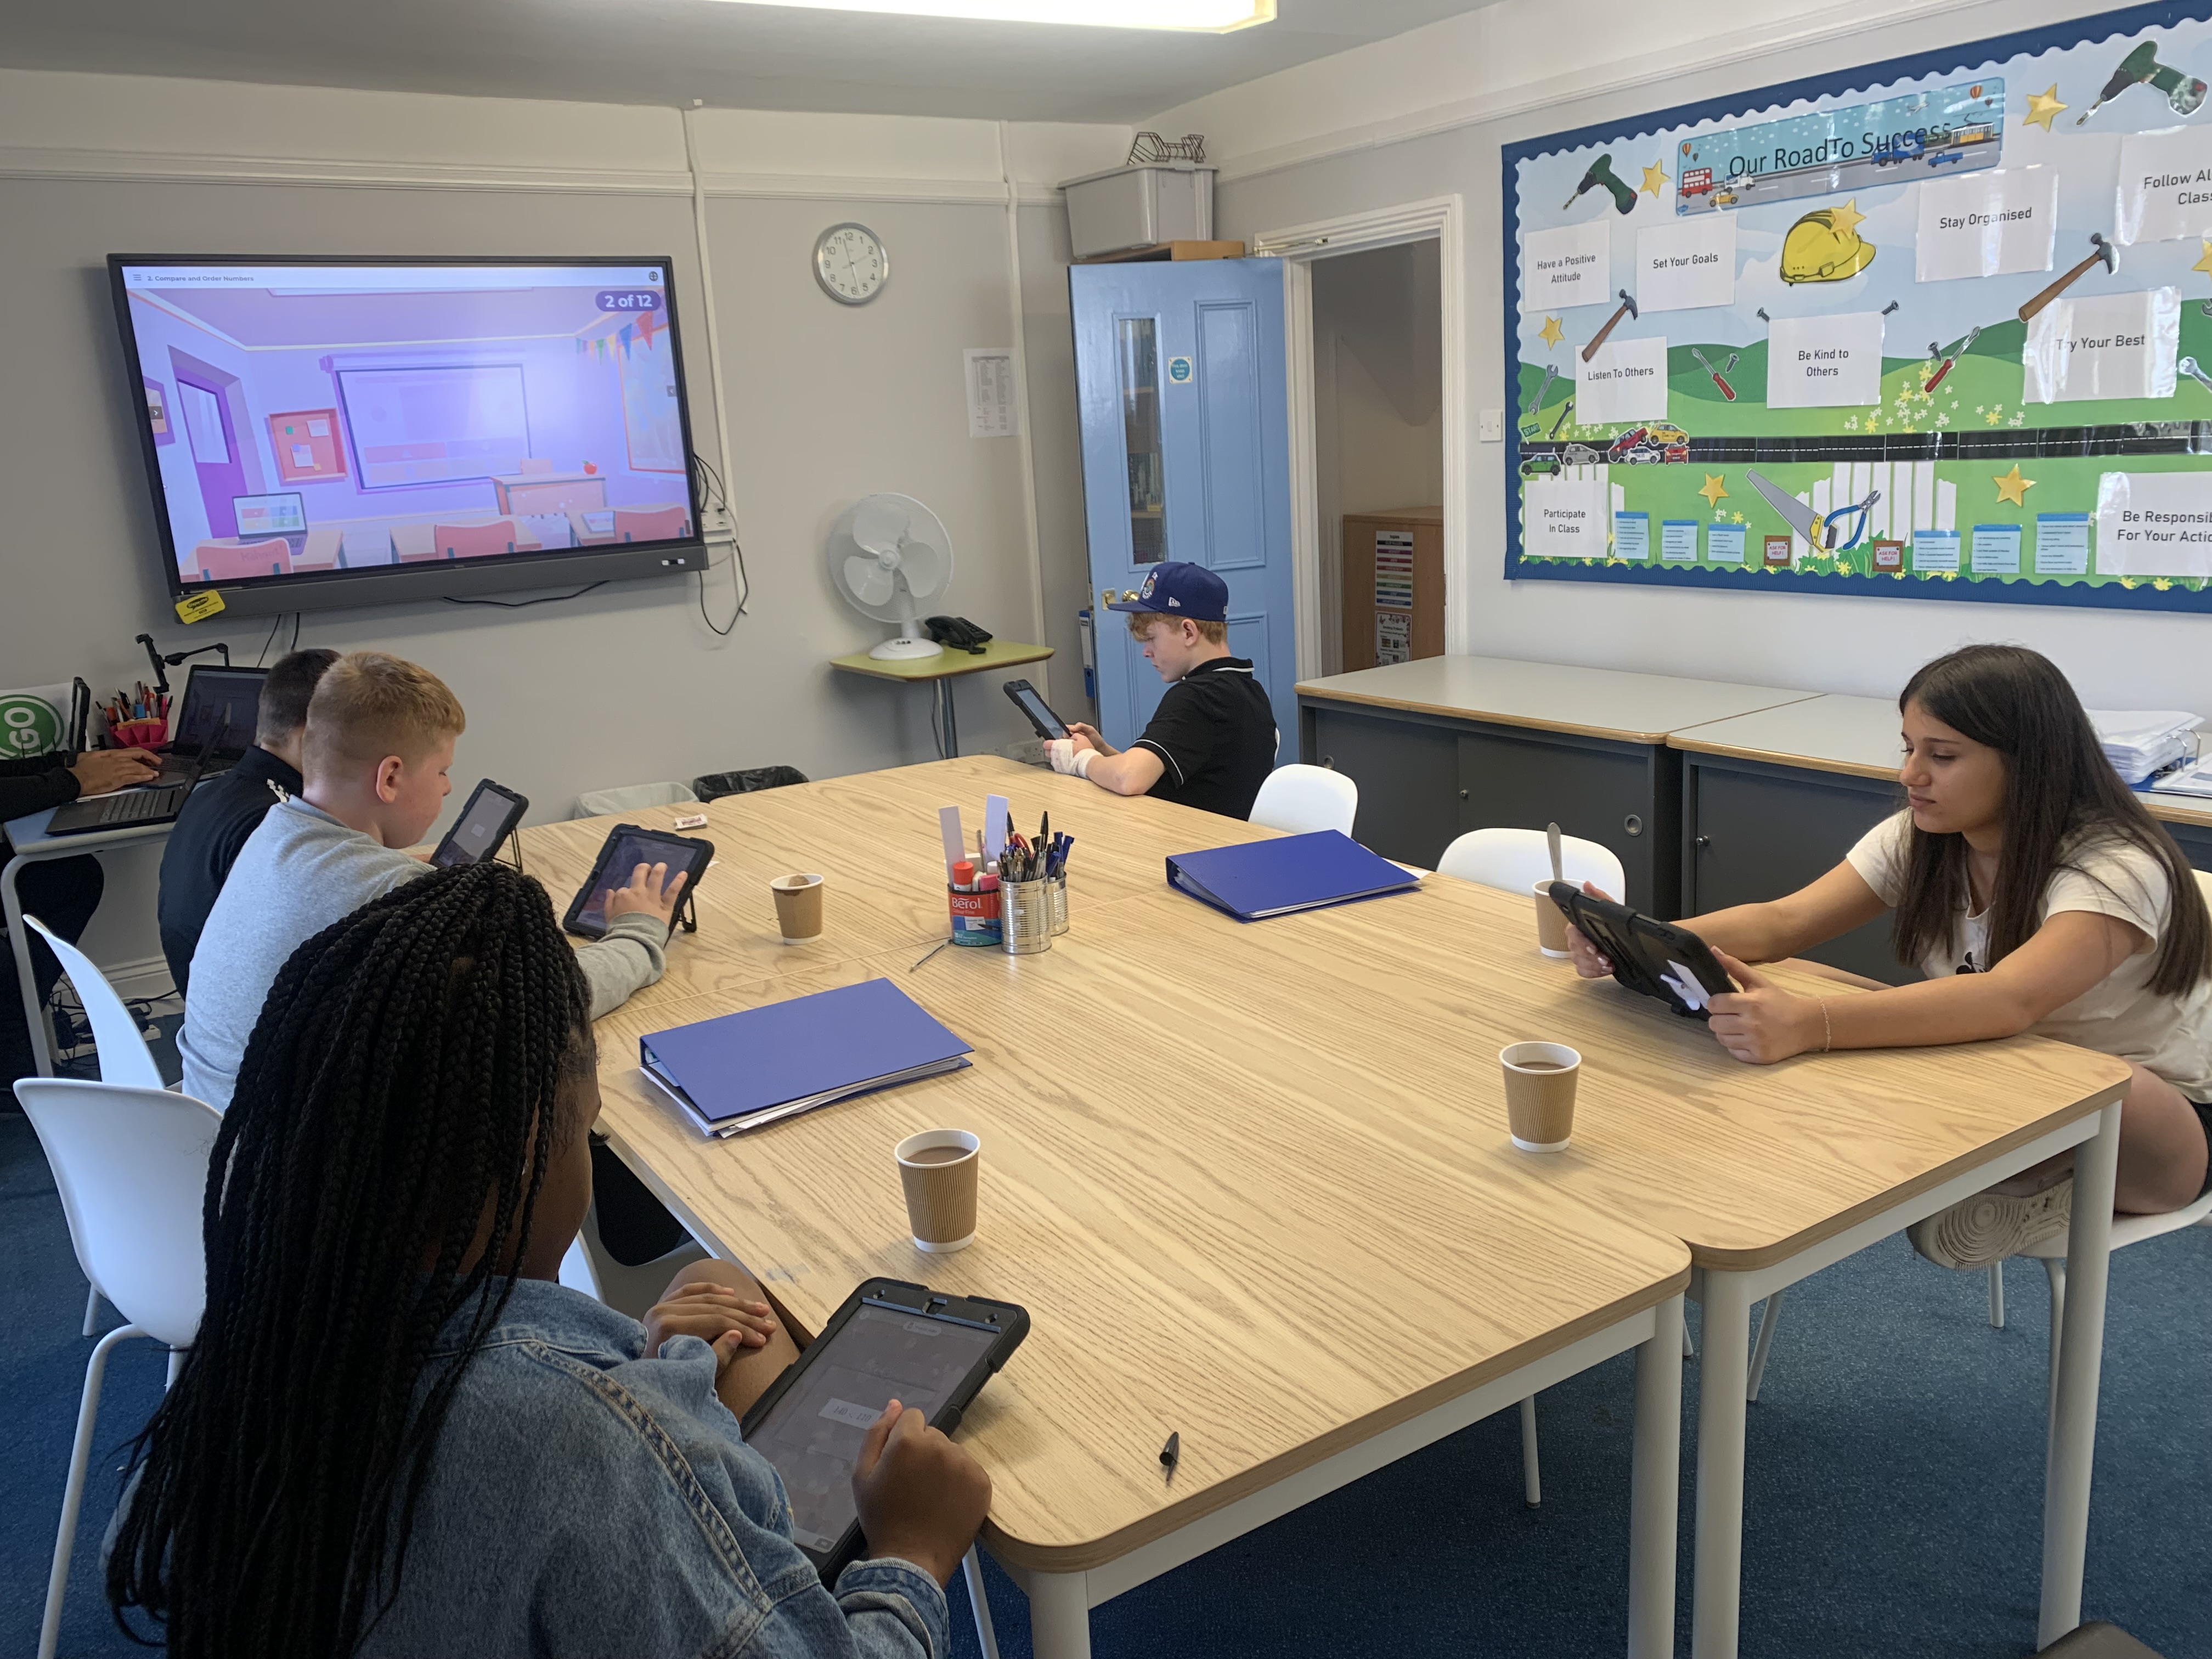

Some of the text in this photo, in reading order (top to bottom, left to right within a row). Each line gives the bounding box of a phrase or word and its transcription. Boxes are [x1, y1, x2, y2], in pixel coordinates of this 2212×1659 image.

[1730, 156, 1767, 177] Our
[1861, 122, 1951, 155] Success
[2144, 174, 2192, 189] Follow
[2178, 191, 2212, 205] Clas
[1939, 206, 2032, 229] Stay Organised
[834, 236, 842, 245] 11
[844, 232, 854, 241] 12
[859, 236, 864, 244] 1
[826, 246, 836, 255] 10
[868, 246, 874, 255] 2
[825, 260, 831, 268] 9
[872, 259, 878, 268] 3
[1537, 261, 1556, 270] Have
[1565, 254, 1596, 266] Positive
[1653, 252, 1718, 269] Set Your Goals
[870, 273, 876, 281] 4
[1551, 272, 1581, 284] Attitude
[851, 287, 857, 295] 6
[862, 283, 868, 291] 5
[605, 294, 653, 308] 2 of 12
[2081, 337, 2112, 349] Your
[2115, 334, 2145, 347] Best
[1798, 349, 1849, 360] Be Kind to
[1588, 366, 1654, 381] Listen To Others
[1807, 366, 1838, 377] Others
[1523, 424, 1539, 436] START
[1544, 509, 1586, 520] Participate
[2123, 510, 2140, 522] Be
[1549, 524, 1580, 533] In Class
[2118, 529, 2141, 540] For
[2145, 529, 2176, 541] Your
[951, 897, 981, 909] Berol
